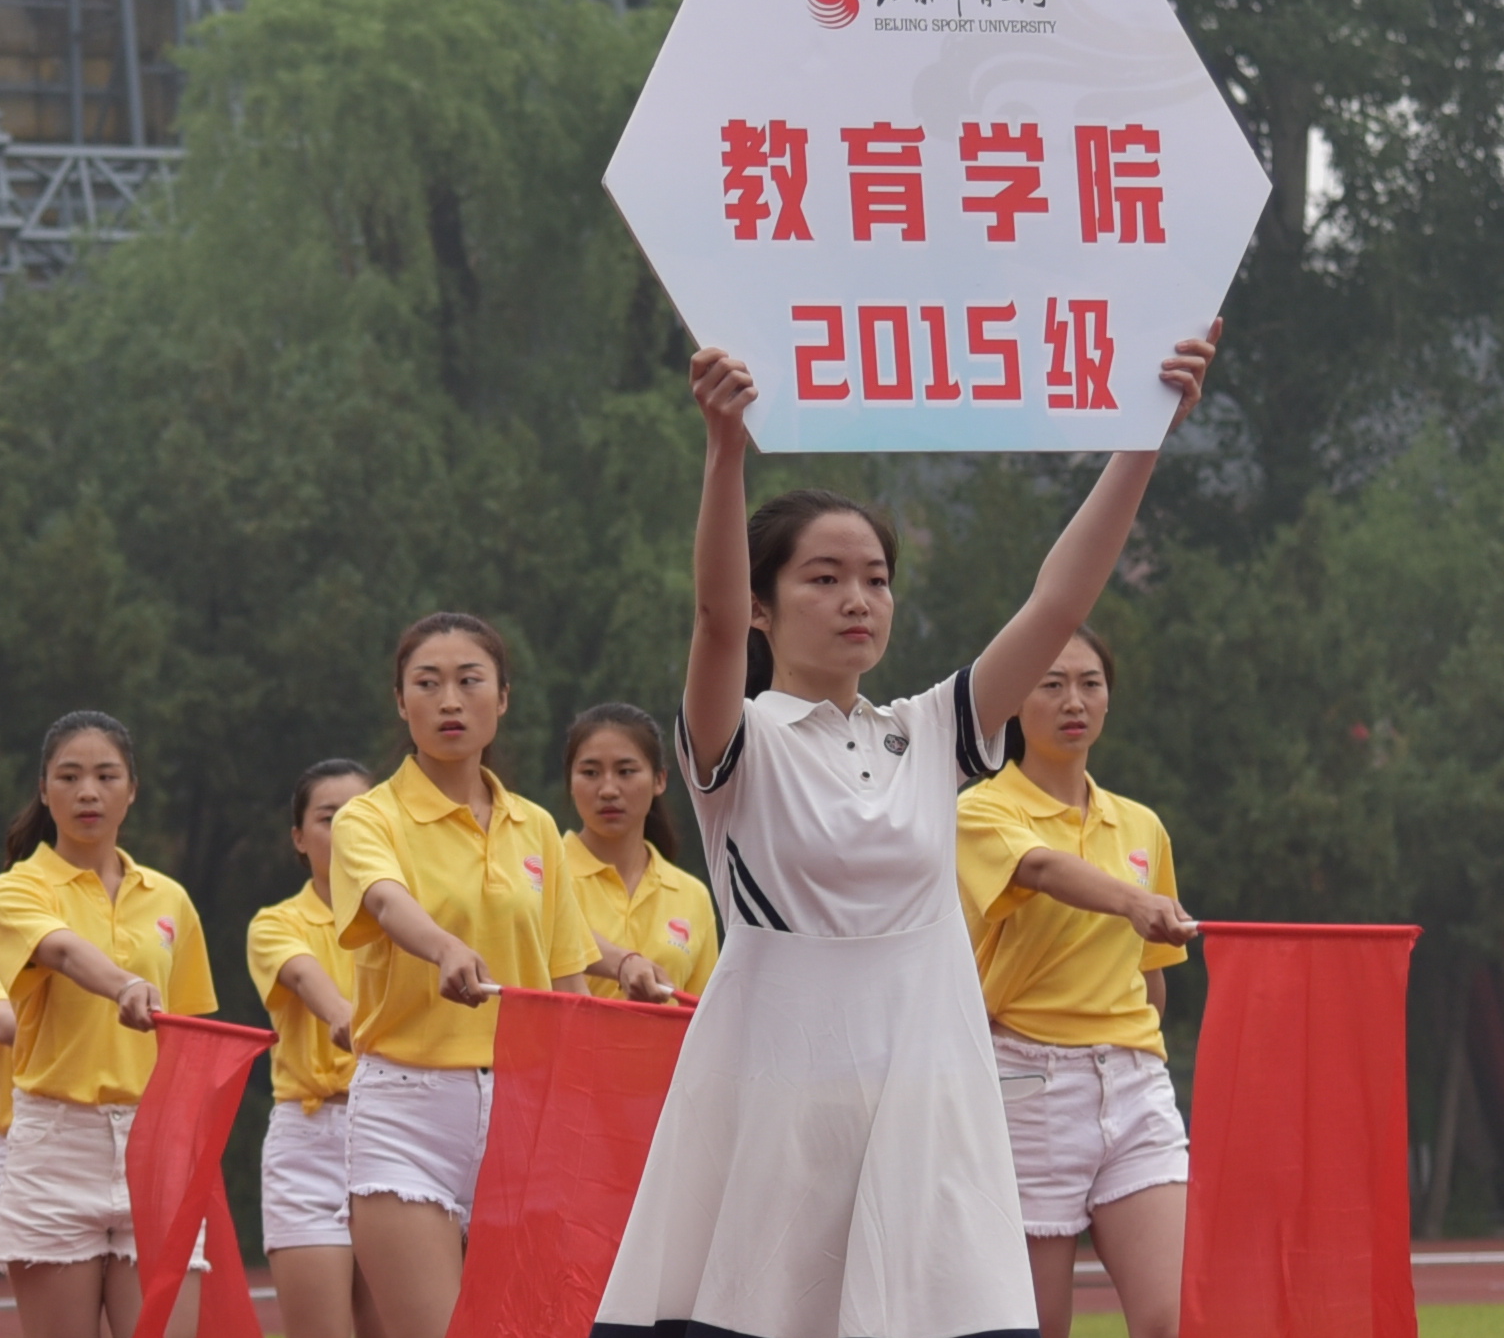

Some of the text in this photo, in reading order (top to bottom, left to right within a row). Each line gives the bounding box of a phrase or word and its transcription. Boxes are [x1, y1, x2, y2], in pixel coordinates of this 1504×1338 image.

[874, 18, 1057, 34] BEIJING SPORT UNIVERSITY
[720, 119, 1166, 244] 教育学院
[791, 297, 1119, 411] 2015级
